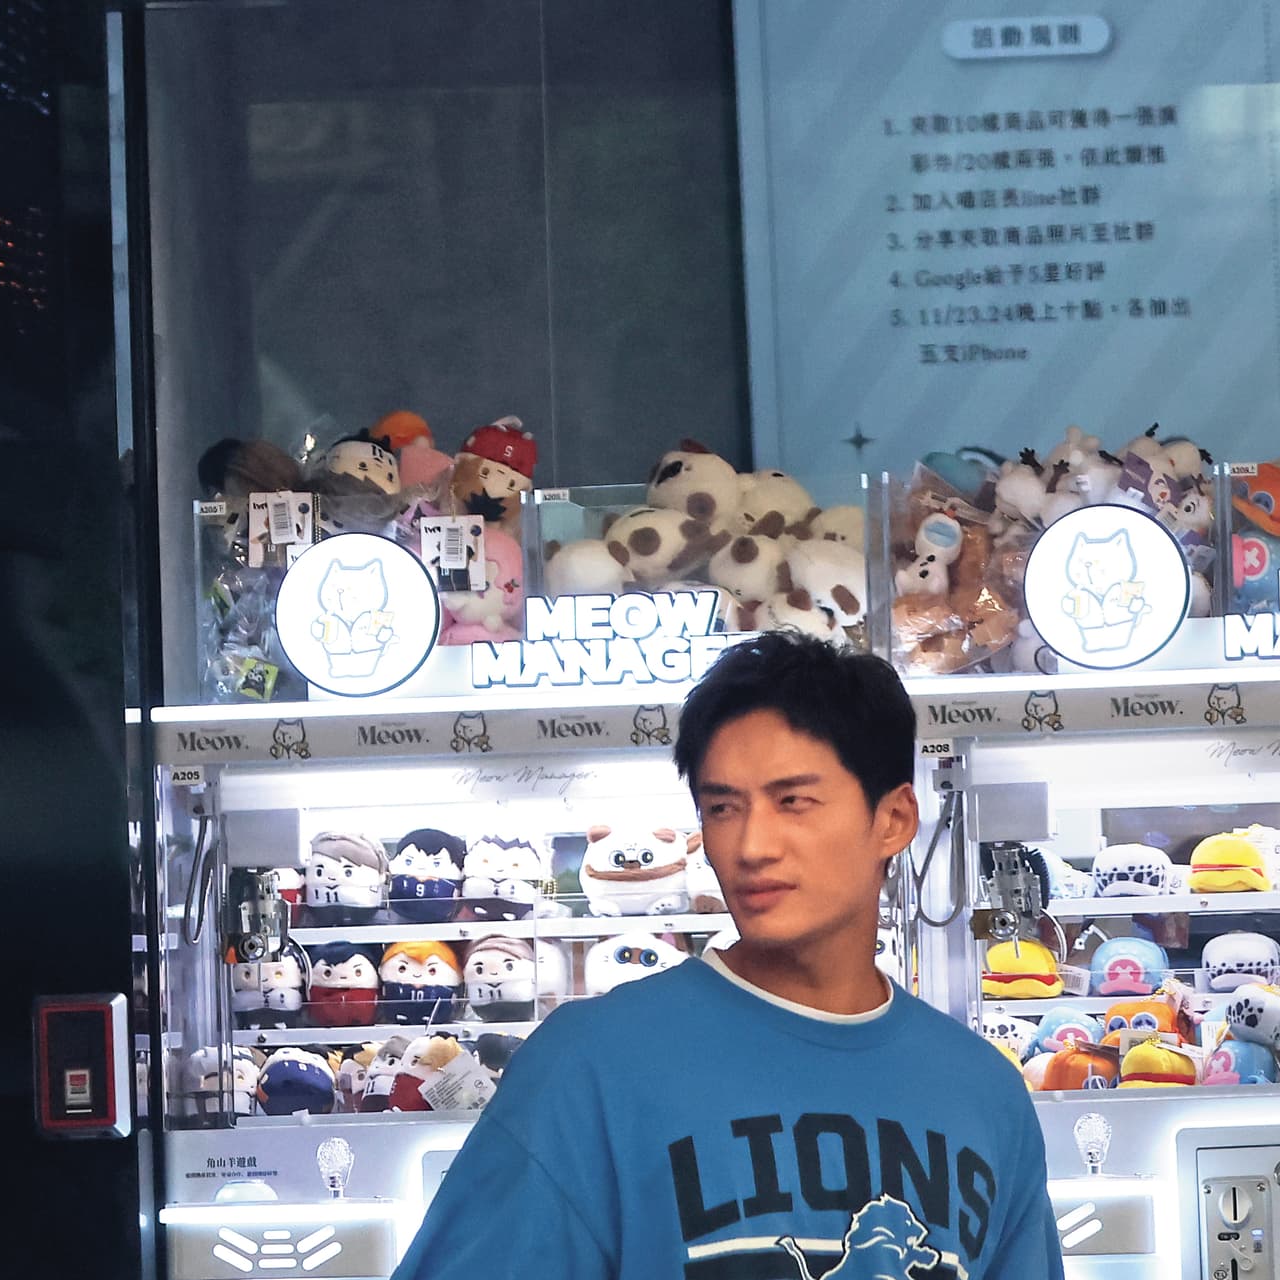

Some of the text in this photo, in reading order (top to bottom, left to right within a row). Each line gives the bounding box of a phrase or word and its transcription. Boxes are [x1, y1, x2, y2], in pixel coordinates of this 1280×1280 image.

[523, 590, 720, 641] MEOW
[471, 633, 760, 688] MANAGE
[172, 771, 201, 782] A205
[669, 1112, 997, 1261] LIONS
